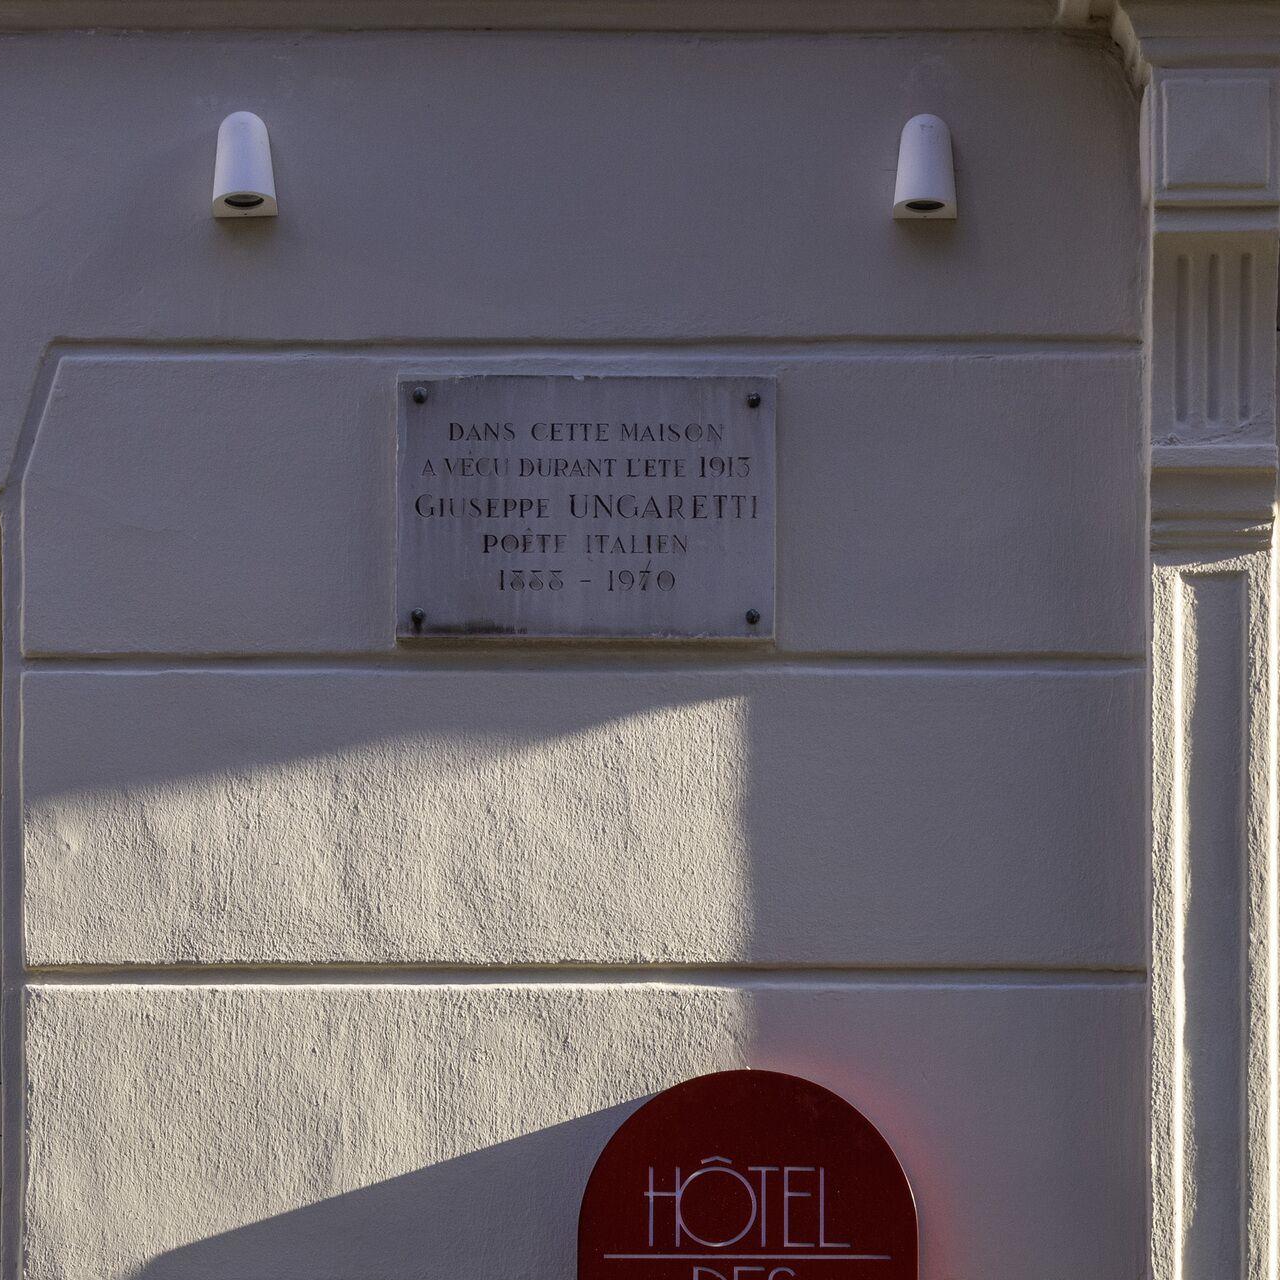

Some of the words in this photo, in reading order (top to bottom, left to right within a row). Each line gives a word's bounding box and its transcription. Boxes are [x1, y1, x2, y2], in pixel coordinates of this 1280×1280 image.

[448, 422, 516, 442] DANS
[530, 422, 610, 442] CETTE
[619, 422, 724, 442] MAISON
[421, 458, 437, 477] A
[518, 457, 618, 477] DURANT
[698, 456, 752, 478] 1913
[414, 493, 551, 519] GIUSEPPE
[569, 494, 759, 520] UNGARETTI
[482, 527, 568, 554] POÊTE
[585, 534, 689, 554] ITALIEN
[498, 569, 564, 592] 1888
[607, 560, 676, 592] 1970
[643, 1155, 851, 1248] HÔTEL
